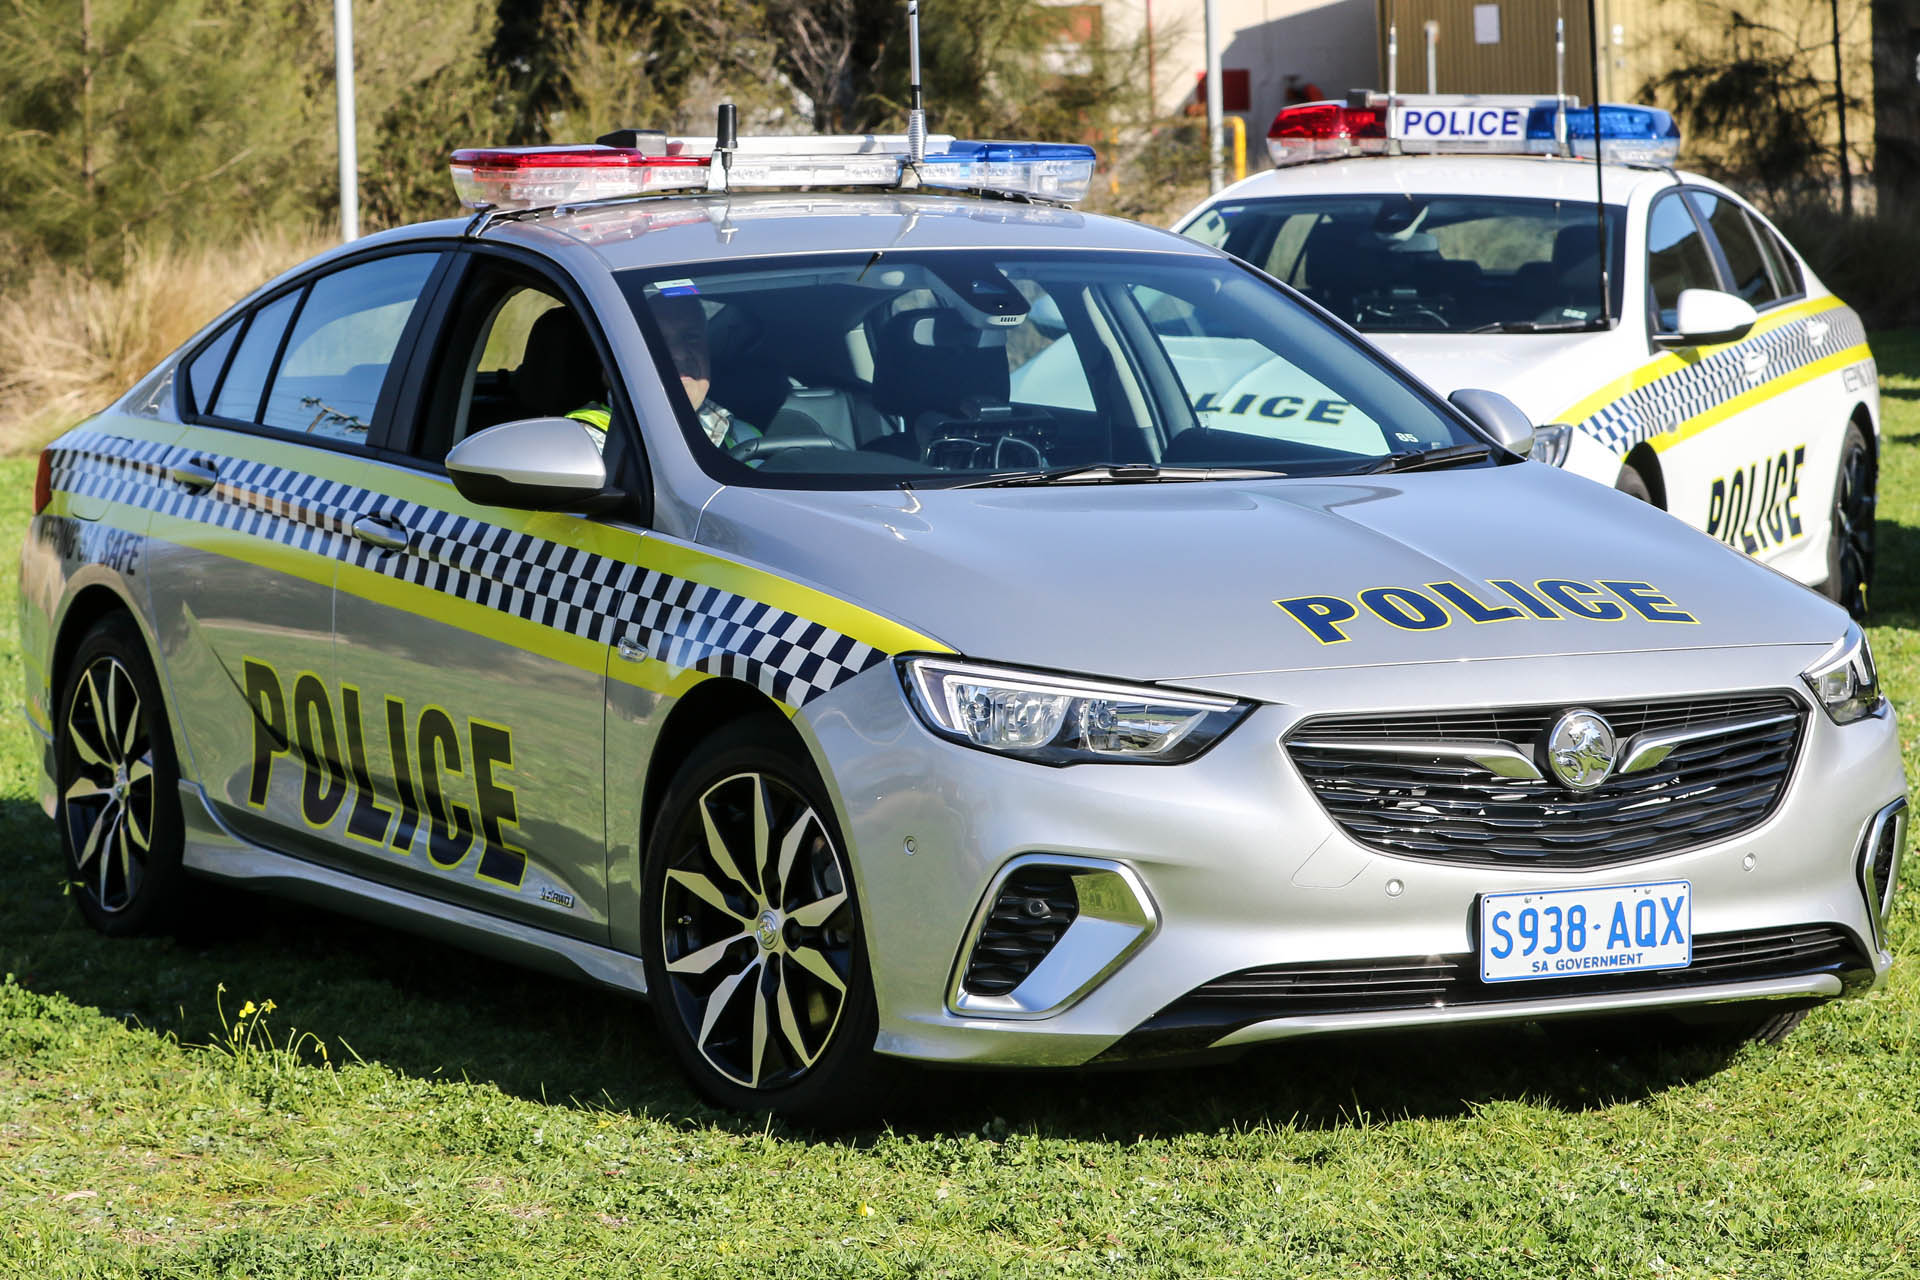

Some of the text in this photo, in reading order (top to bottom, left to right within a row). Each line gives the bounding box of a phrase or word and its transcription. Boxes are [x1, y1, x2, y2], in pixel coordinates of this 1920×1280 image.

[1403, 110, 1520, 137] POLICE
[1192, 393, 1350, 425] LICE
[1706, 443, 1805, 557] POLICE
[1273, 579, 1701, 645] POLICE
[242, 655, 528, 892] POLICE
[1532, 952, 1643, 973] SA GOVERNMENT
